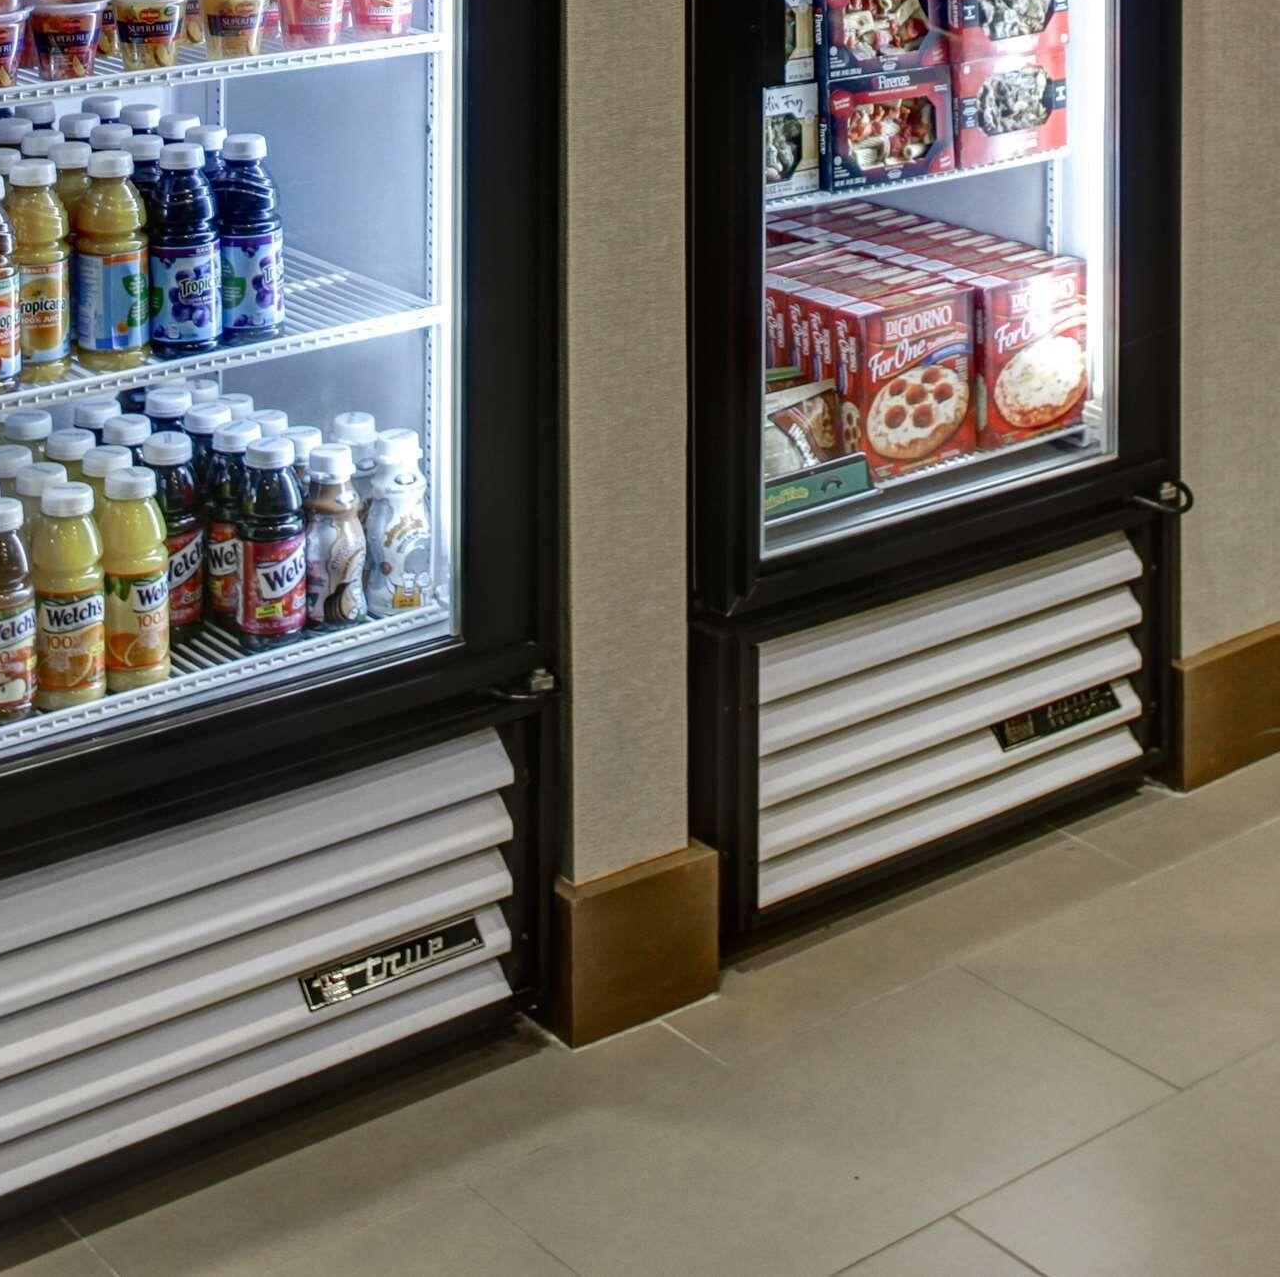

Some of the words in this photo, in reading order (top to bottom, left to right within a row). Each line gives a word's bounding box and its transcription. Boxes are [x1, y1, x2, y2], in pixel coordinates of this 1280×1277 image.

[878, 75, 911, 90] Firenze
[994, 323, 1023, 354] For
[868, 350, 895, 384] For
[895, 338, 928, 369] One
[263, 551, 306, 592] Welc
[136, 581, 169, 607] Welc
[47, 600, 103, 628] Welch's
